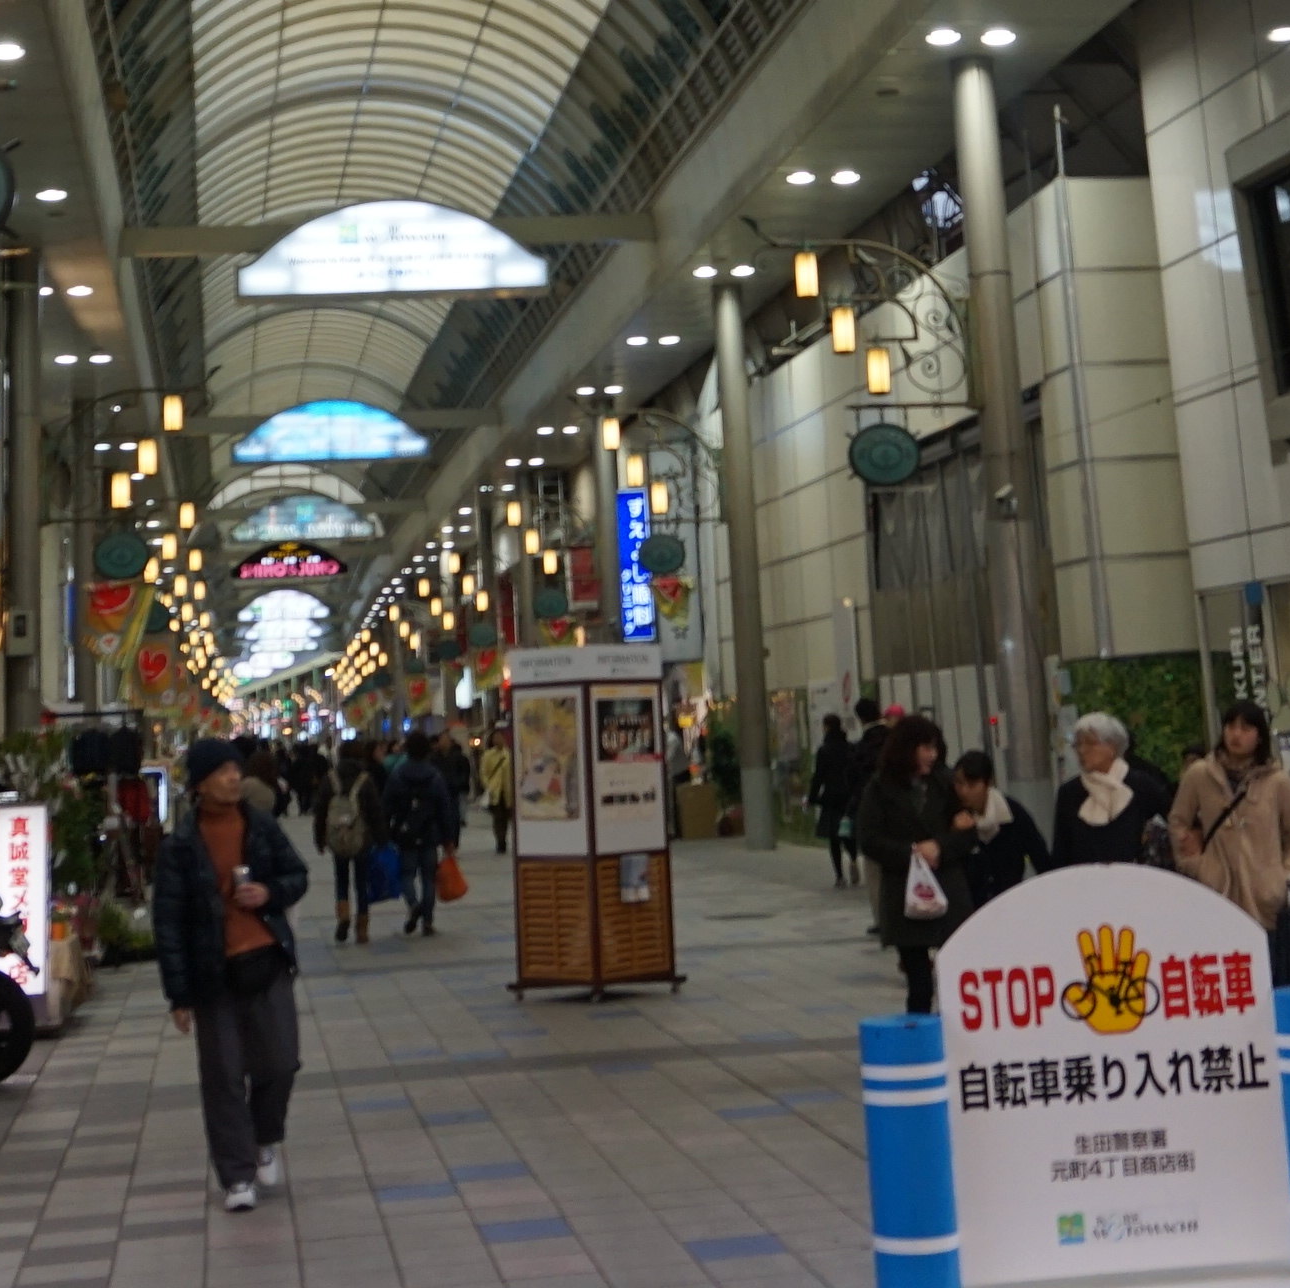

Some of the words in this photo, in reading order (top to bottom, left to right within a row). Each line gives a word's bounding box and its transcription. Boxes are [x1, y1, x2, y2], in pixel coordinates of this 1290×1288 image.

[959, 965, 1055, 1031] STOP
[1160, 950, 1256, 1019] 自転車
[959, 1042, 1270, 1113] 自転車乗り入れ禁止
[1051, 1150, 1197, 1182] 元町4丁目商店街
